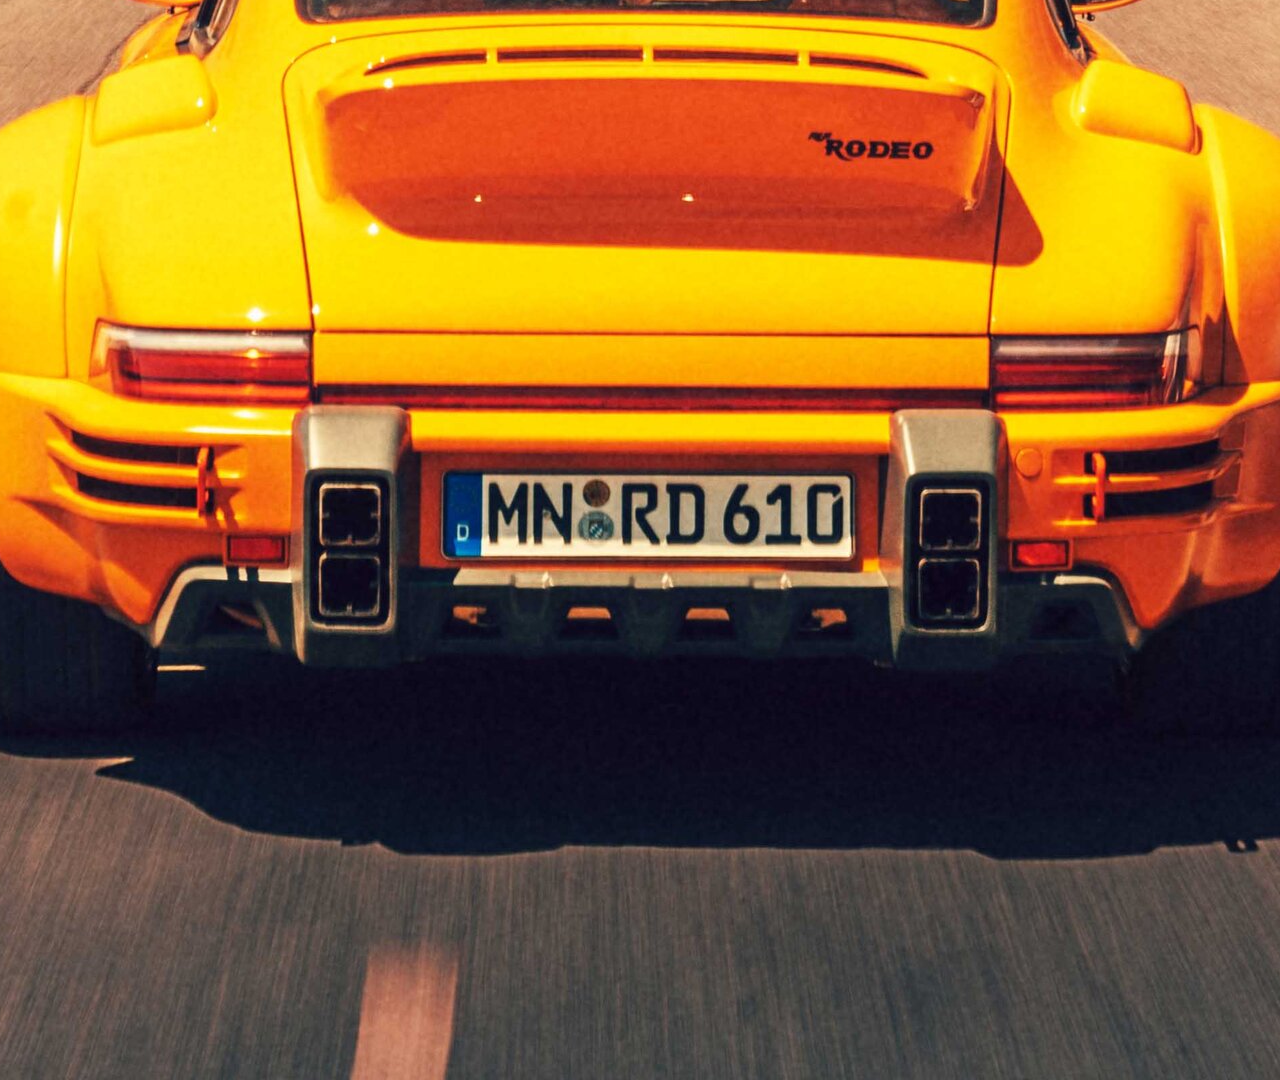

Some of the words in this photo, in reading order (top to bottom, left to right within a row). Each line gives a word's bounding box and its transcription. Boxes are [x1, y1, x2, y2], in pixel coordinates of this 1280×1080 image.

[825, 139, 934, 161] RODEO
[488, 482, 573, 545] MN
[622, 482, 706, 545] RD
[723, 483, 845, 546] 610
[456, 524, 469, 541] D
